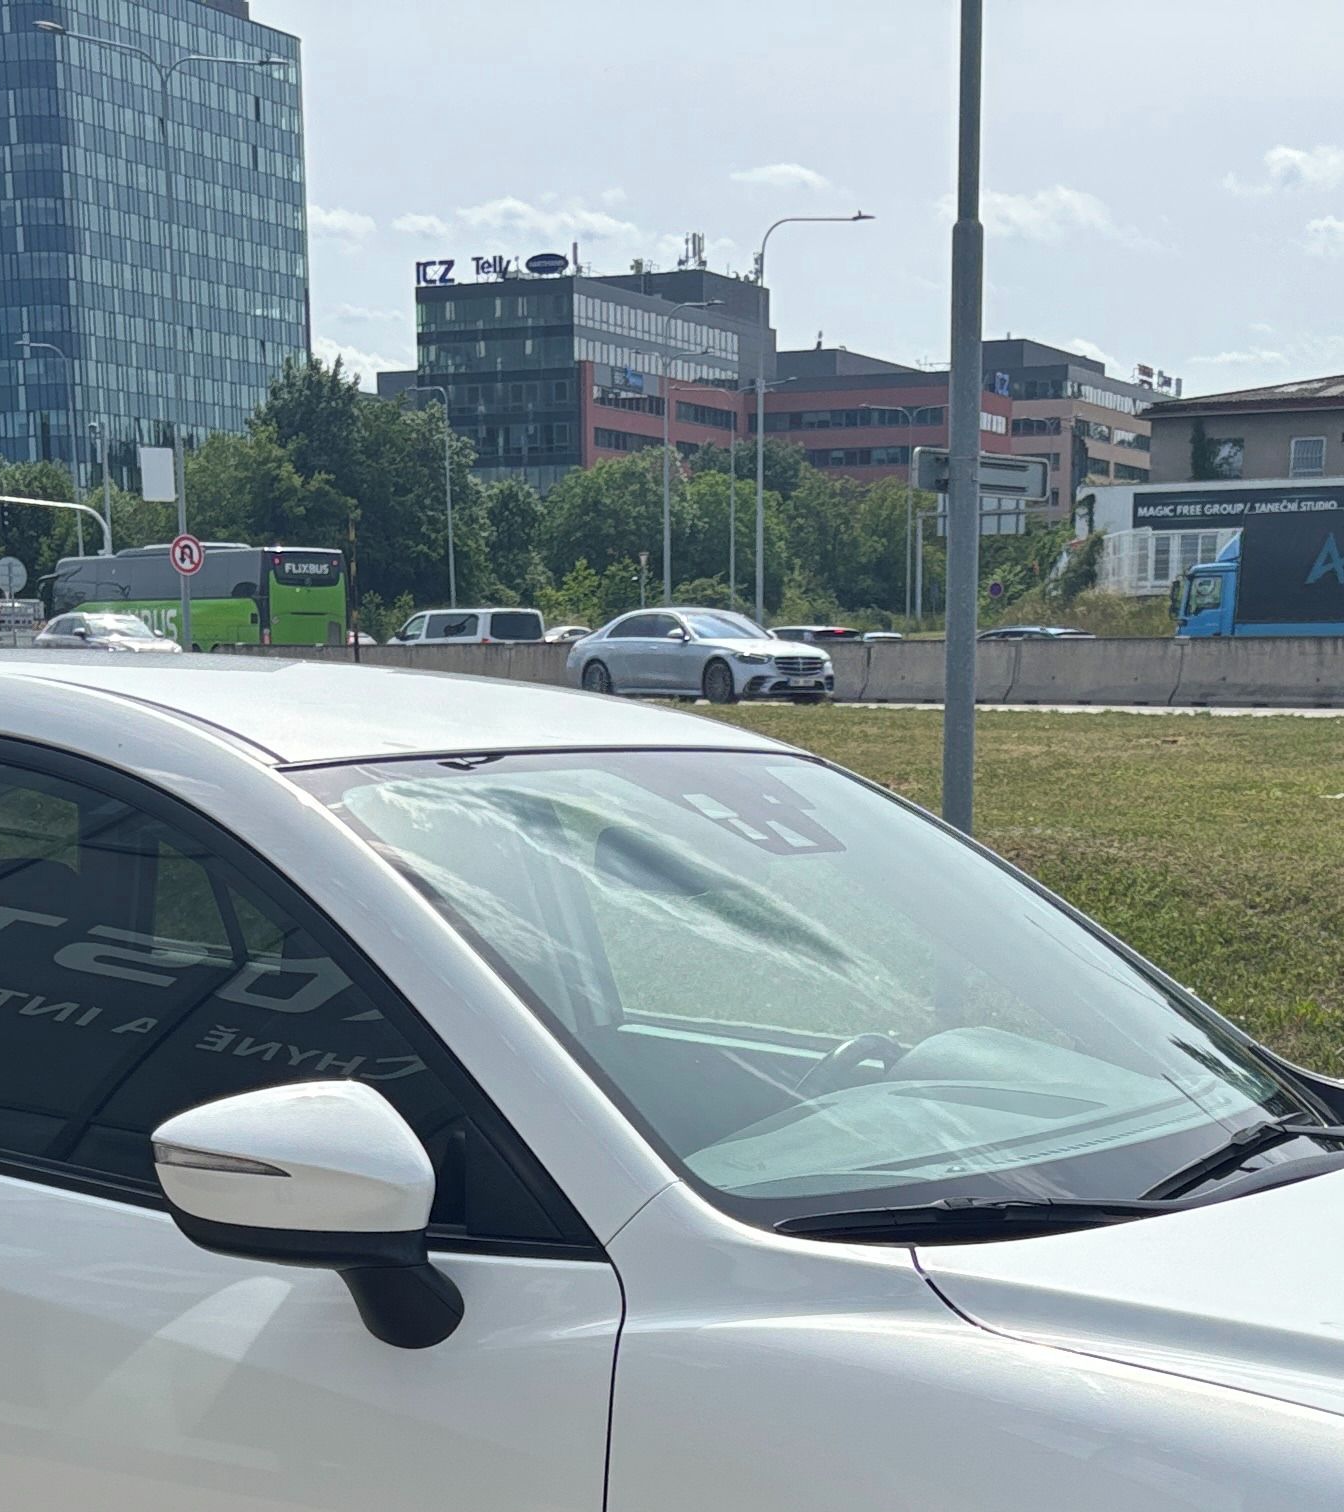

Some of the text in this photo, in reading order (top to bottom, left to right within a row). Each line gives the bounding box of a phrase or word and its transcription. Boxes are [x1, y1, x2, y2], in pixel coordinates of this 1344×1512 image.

[415, 259, 455, 285] ICZ
[471, 255, 511, 279] Telly
[1137, 506, 1175, 517] MAGIC
[1176, 504, 1202, 516] FREE
[1300, 501, 1338, 511] STUDIO
[284, 562, 330, 575] FLIXBUS
